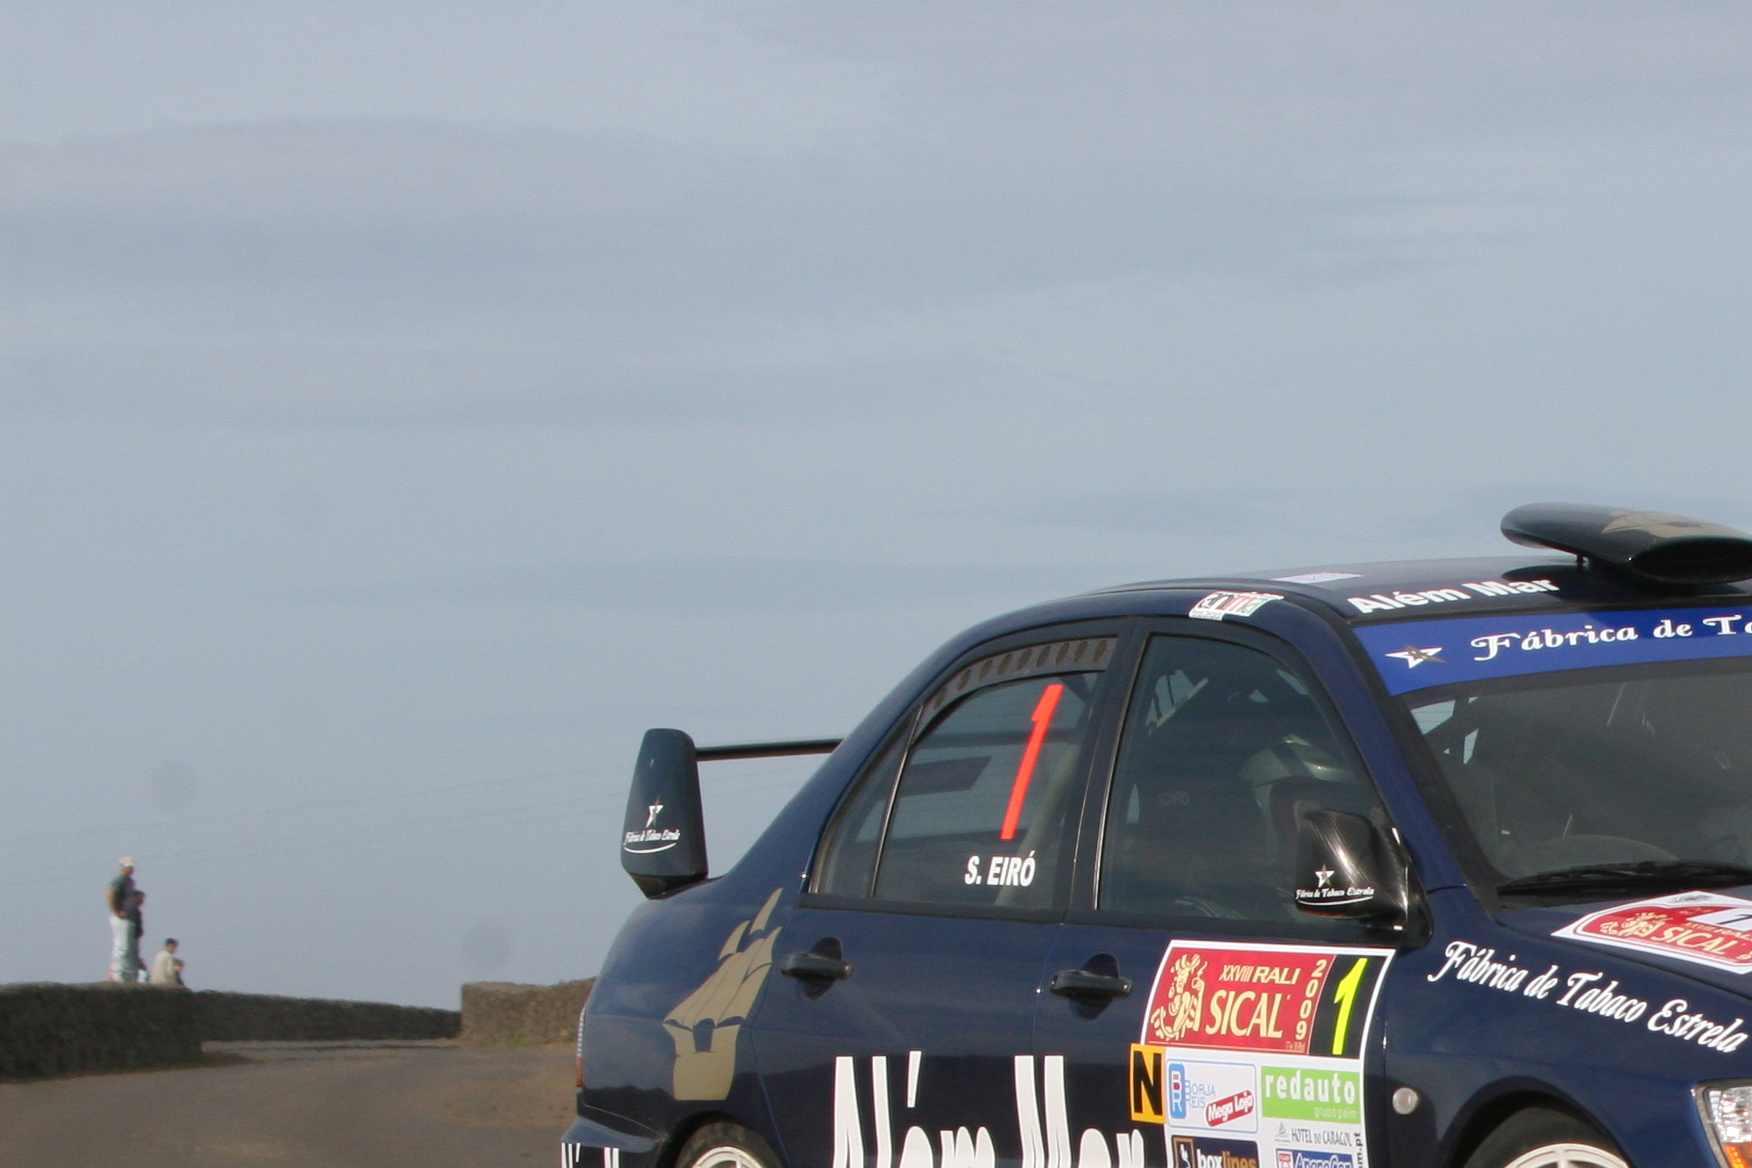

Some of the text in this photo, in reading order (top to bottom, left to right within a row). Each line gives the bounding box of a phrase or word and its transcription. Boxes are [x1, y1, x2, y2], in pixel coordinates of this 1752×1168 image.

[1347, 580, 1560, 614] Além Mar
[1470, 625, 1638, 661] Fábrica
[1653, 619, 1693, 639] de
[1001, 684, 1065, 840] 1
[965, 850, 1036, 886] S. EIRÓ
[1651, 926, 1739, 955] SICAL
[1252, 966, 1301, 985] RALI
[1205, 989, 1283, 1039] SICAL
[1334, 958, 1368, 1055] 1
[1427, 941, 1749, 1053] Fábrica de Tabaco Estrela
[1133, 1051, 1162, 1115] N
[1264, 1070, 1355, 1104] redauto
